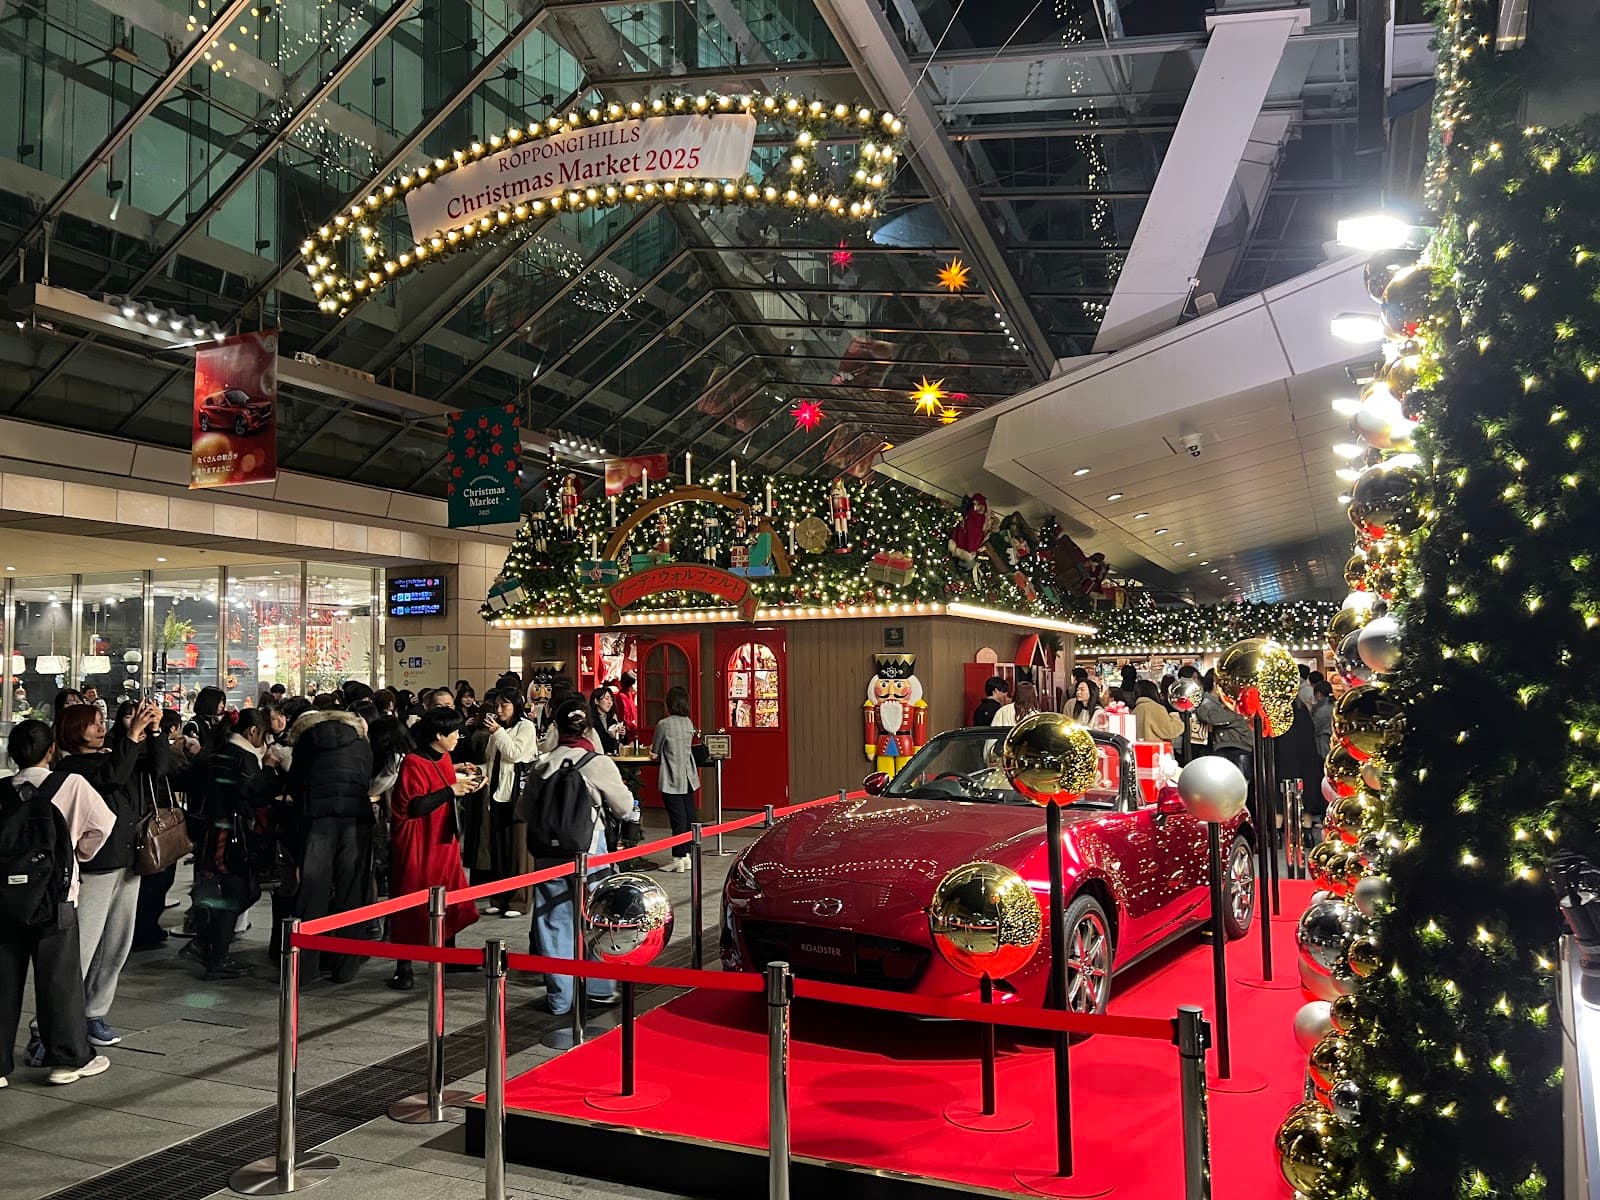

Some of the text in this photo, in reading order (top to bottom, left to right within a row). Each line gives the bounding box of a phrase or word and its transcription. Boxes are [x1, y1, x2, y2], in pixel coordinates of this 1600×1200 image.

[499, 126, 640, 172] ROPPONGI HILLS
[447, 147, 702, 219] Christmas Market 2025
[463, 486, 506, 497] Christmas
[469, 497, 499, 507] Market
[800, 943, 841, 956] ROADSTER
